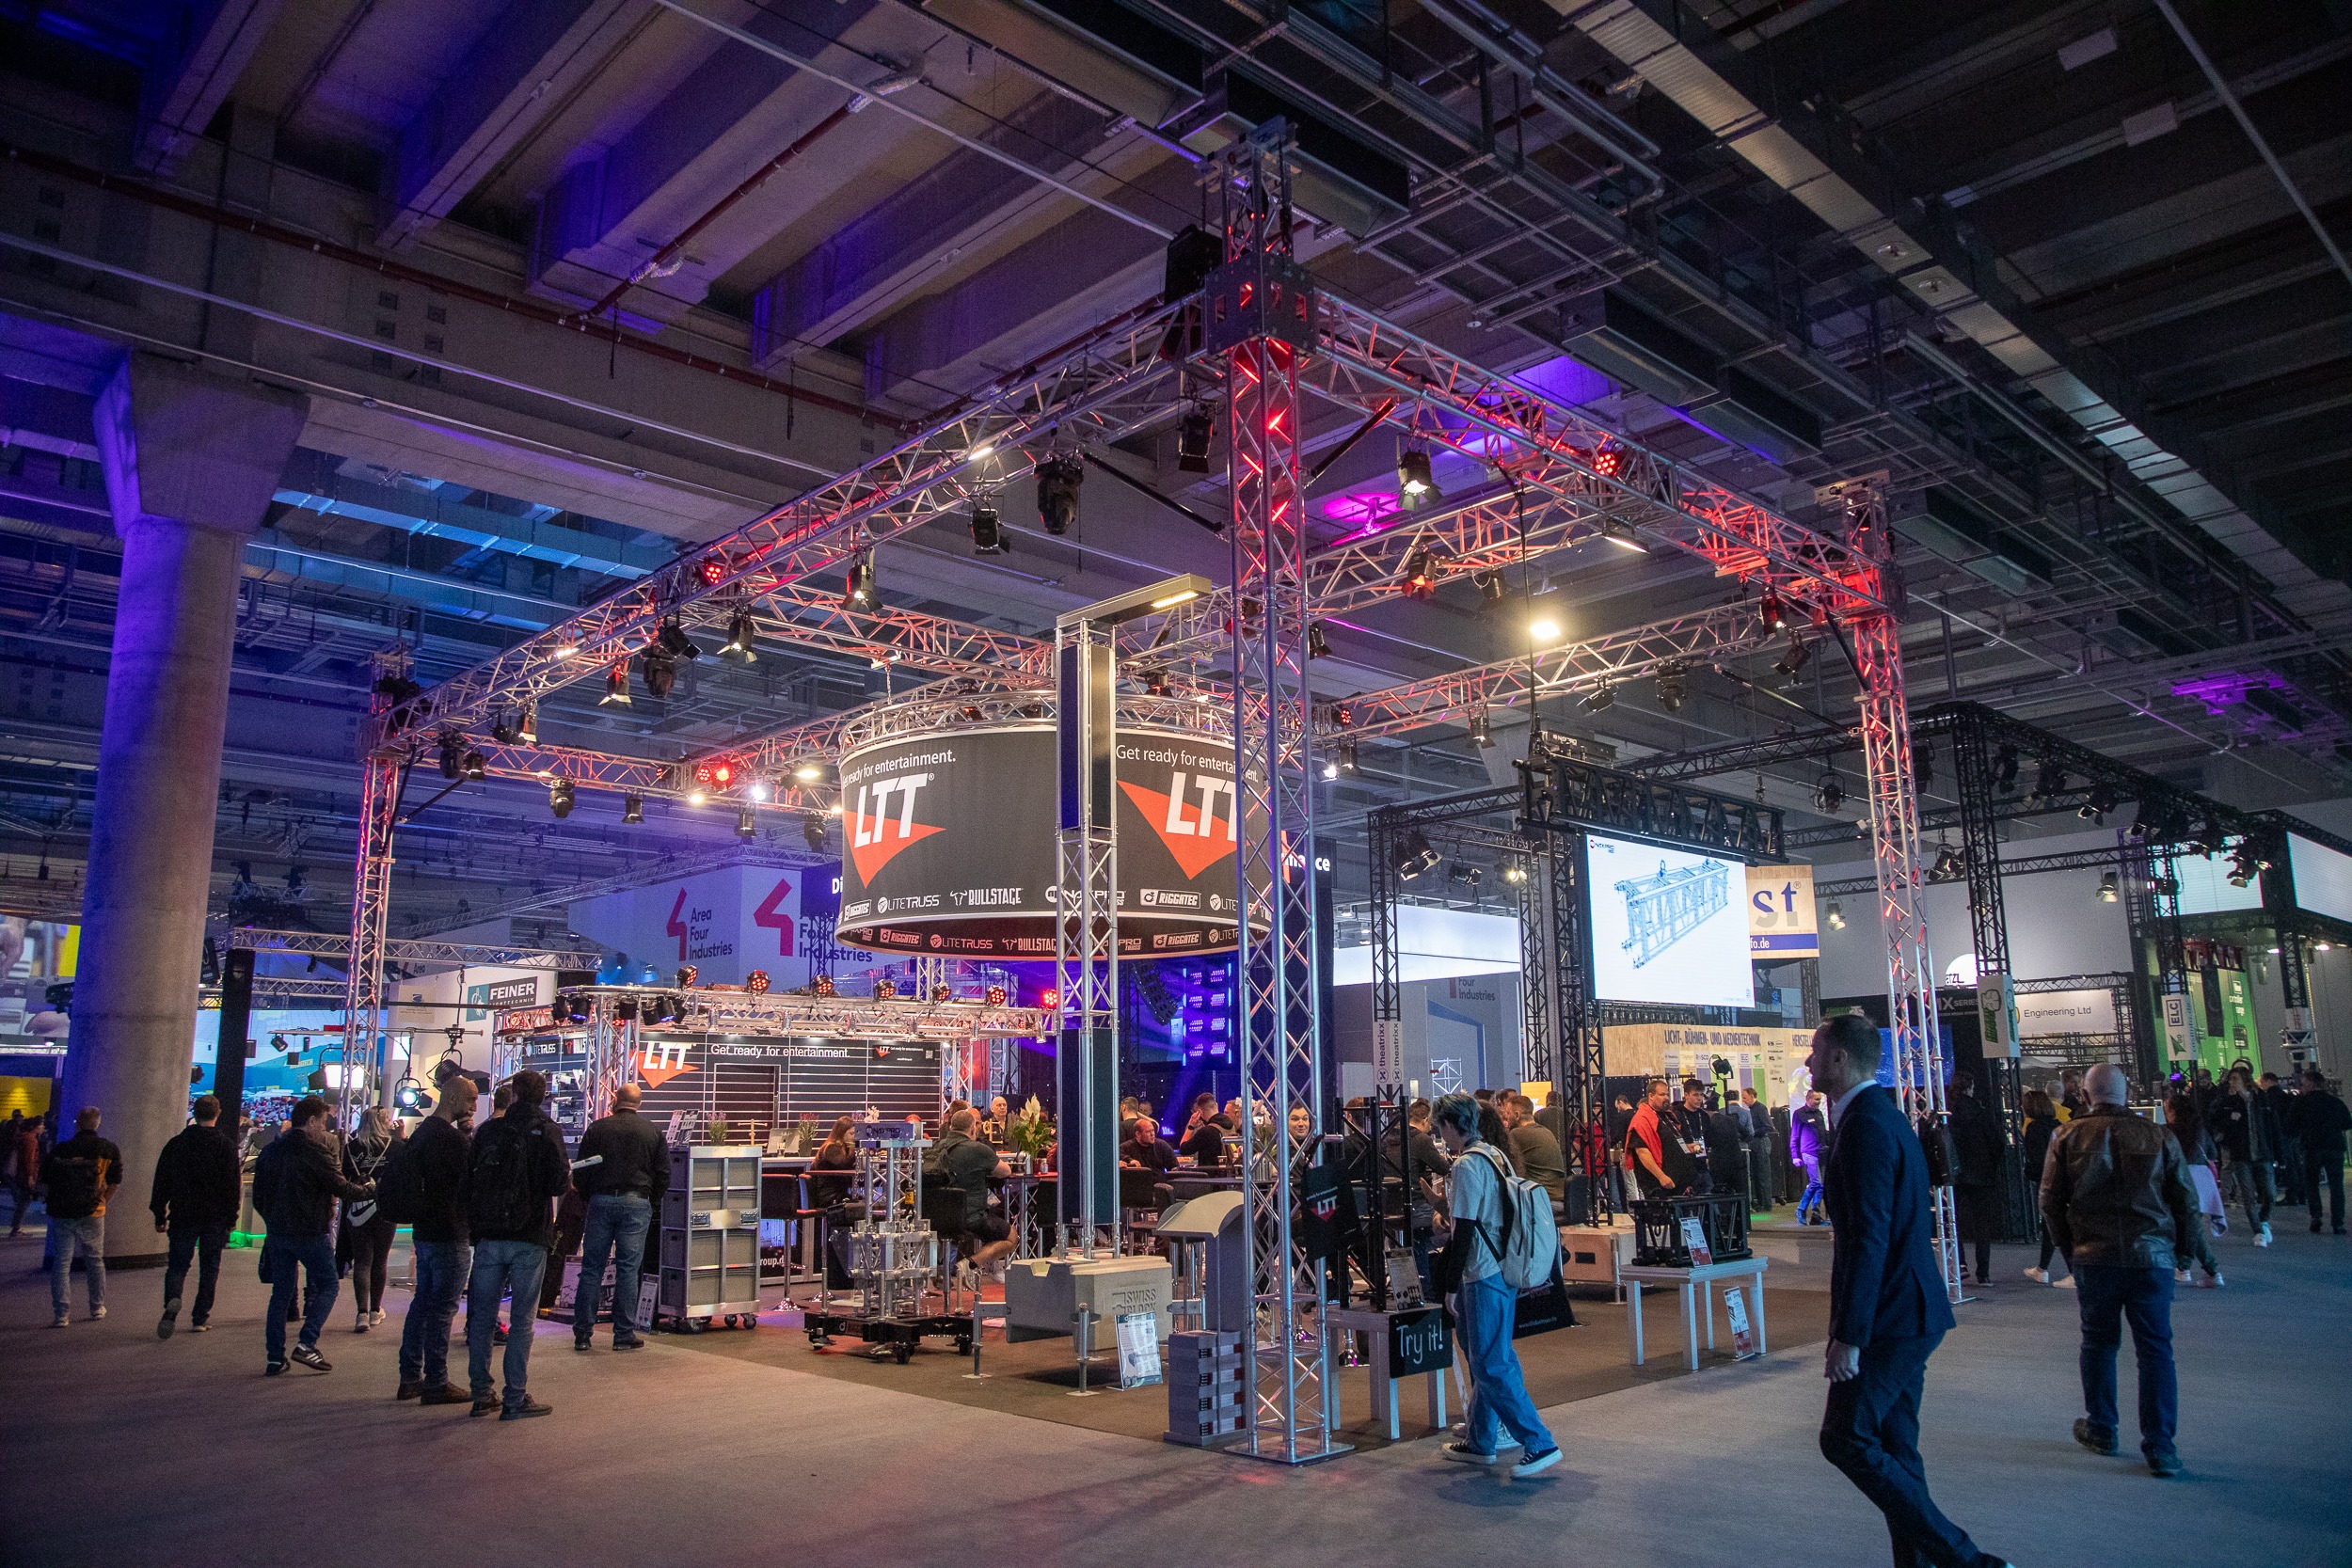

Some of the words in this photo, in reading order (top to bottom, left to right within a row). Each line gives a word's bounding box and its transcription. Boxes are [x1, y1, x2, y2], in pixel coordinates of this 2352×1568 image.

[1116, 744, 1140, 761] Get
[1143, 749, 1178, 767] ready
[1181, 751, 1197, 767] for
[848, 766, 863, 784] ready
[864, 763, 874, 778] for
[875, 749, 957, 774] entertainment.
[854, 772, 929, 848] LTT
[968, 888, 1022, 906] BULLSTAGE
[691, 907, 712, 923] Area
[690, 926, 708, 941] Four
[689, 942, 733, 959] Industries
[1018, 938, 1057, 952] BULLSTAG
[489, 982, 535, 1000] FEINER
[1459, 989, 1496, 1002] Industries
[2024, 1008, 2075, 1019] Engineering
[2078, 1006, 2091, 1015] Ltd
[2169, 1002, 2180, 1024] ELC
[1709, 1032, 1722, 1046] UND
[643, 1042, 692, 1070] LTT
[710, 1045, 731, 1056] Get
[734, 1045, 762, 1058] ready
[766, 1045, 781, 1056] for
[783, 1046, 850, 1058] entertainment.
[1317, 1195, 1338, 1215] LTT
[1126, 1288, 1157, 1304] SWISS
[1396, 1325, 1422, 1365] Try
[1428, 1319, 1443, 1351] it!
